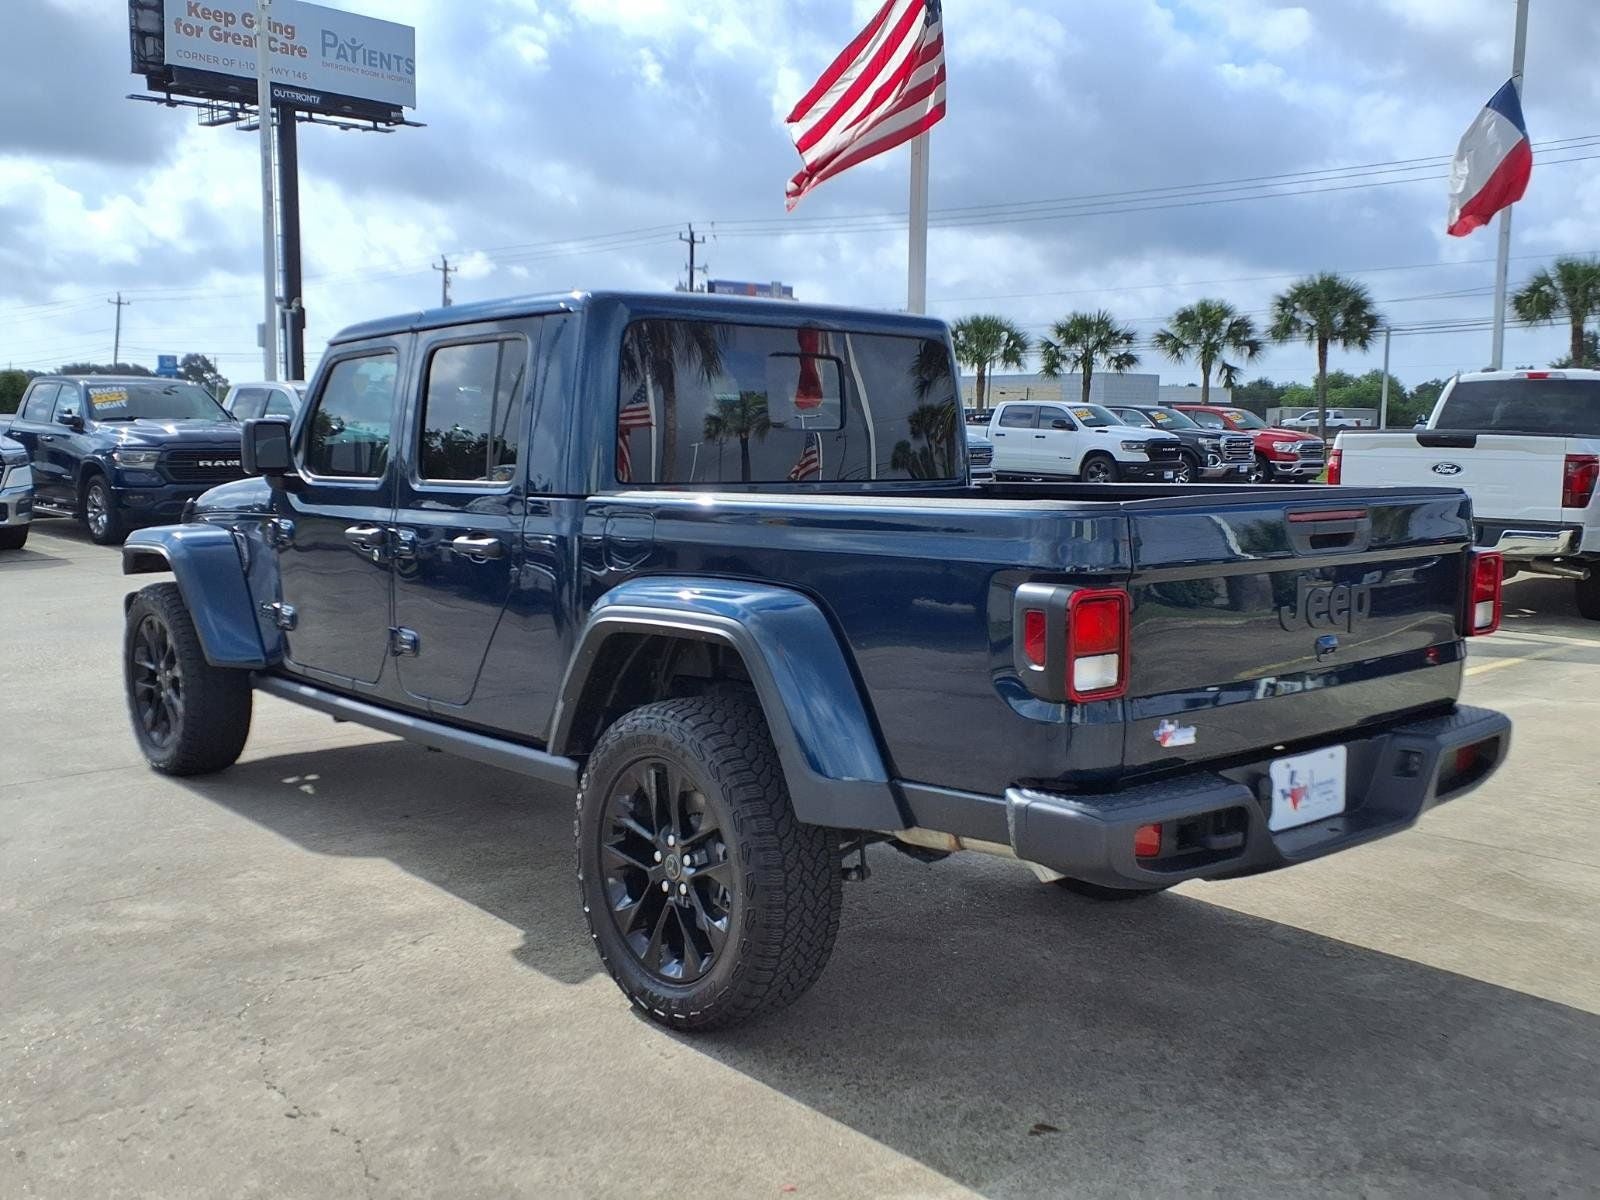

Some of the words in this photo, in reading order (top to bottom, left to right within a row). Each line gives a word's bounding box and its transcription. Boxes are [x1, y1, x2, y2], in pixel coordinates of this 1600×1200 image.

[174, 17, 204, 38] for
[268, 36, 308, 58] Care
[186, 0, 237, 28] Keep
[241, 12, 296, 40] Ging
[176, 49, 219, 66] CORNER
[222, 58, 235, 68] OF
[239, 61, 256, 71] I-10
[321, 28, 415, 76] PATIENTS
[1435, 463, 1457, 474] Ford
[1278, 575, 1372, 634] Jeep
